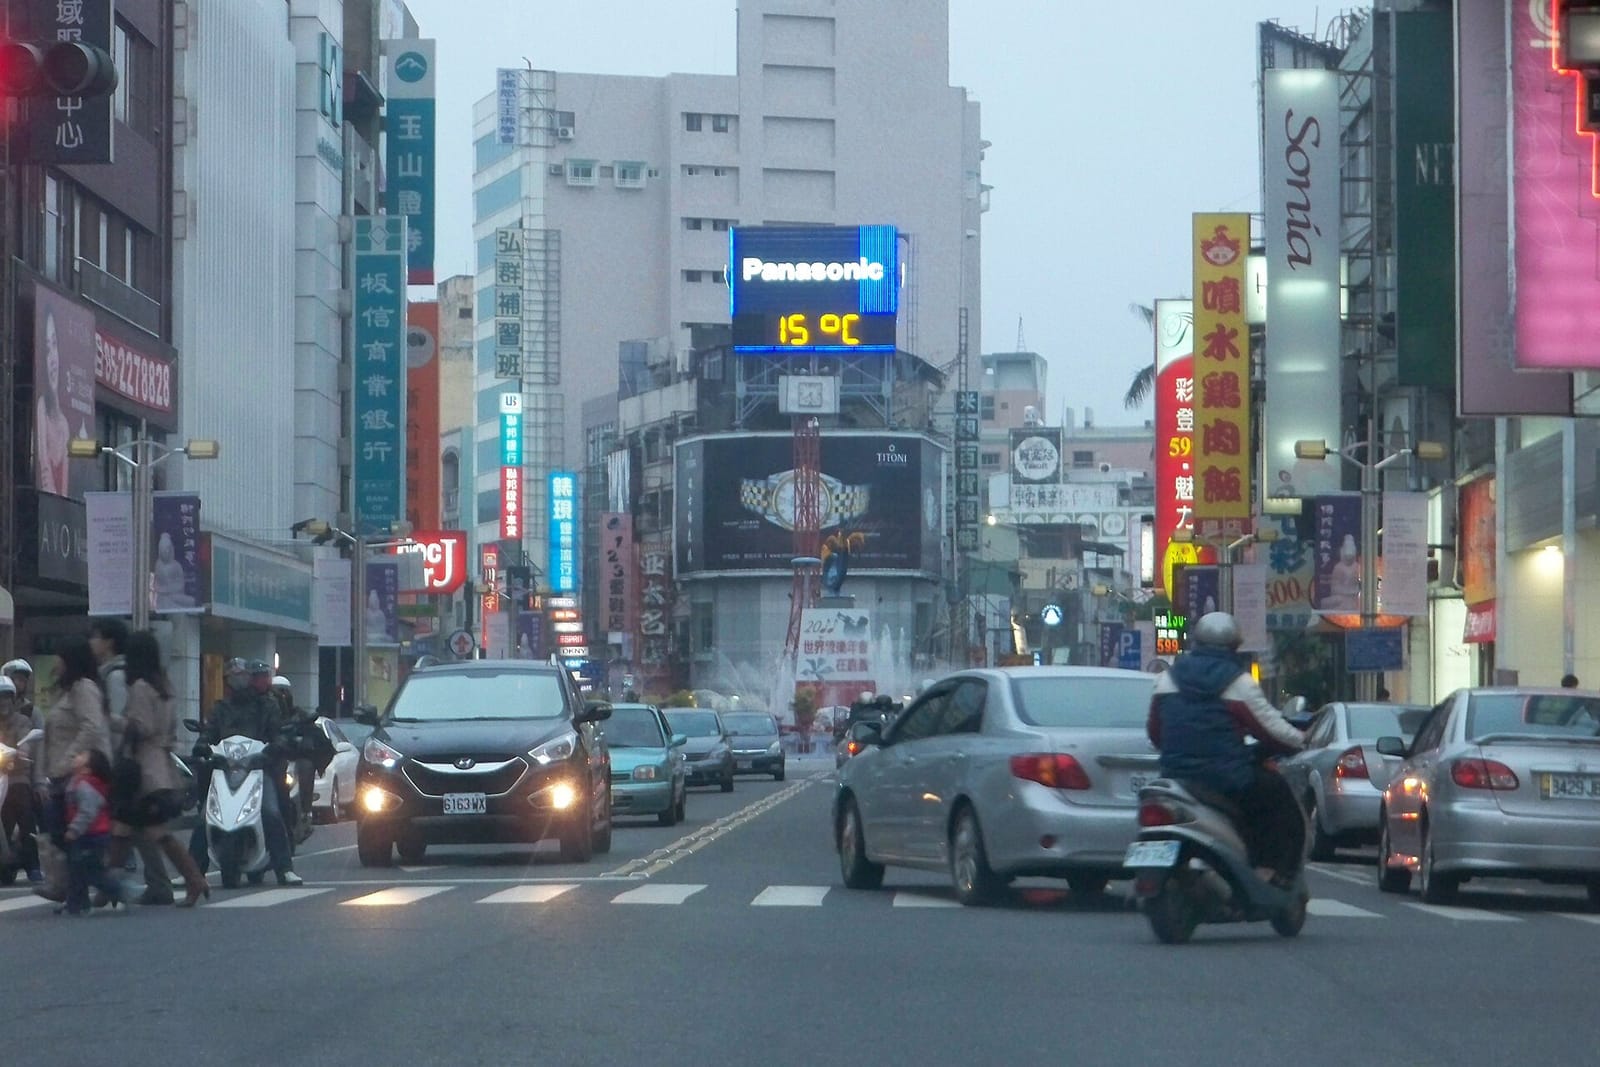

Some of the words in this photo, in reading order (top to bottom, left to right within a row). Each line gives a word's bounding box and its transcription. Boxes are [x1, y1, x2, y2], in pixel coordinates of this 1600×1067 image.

[56, 0, 84, 148] 域中心
[1285, 108, 1321, 271] Sonia
[742, 256, 884, 281] Panasonic
[499, 231, 521, 376] 弘群補習班
[779, 313, 809, 345] 15
[360, 273, 395, 462] 板信商業銀行
[876, 452, 908, 464] TITONI
[562, 647, 586, 655] DKNY
[1120, 632, 1134, 657] P
[1157, 638, 1180, 654] 599
